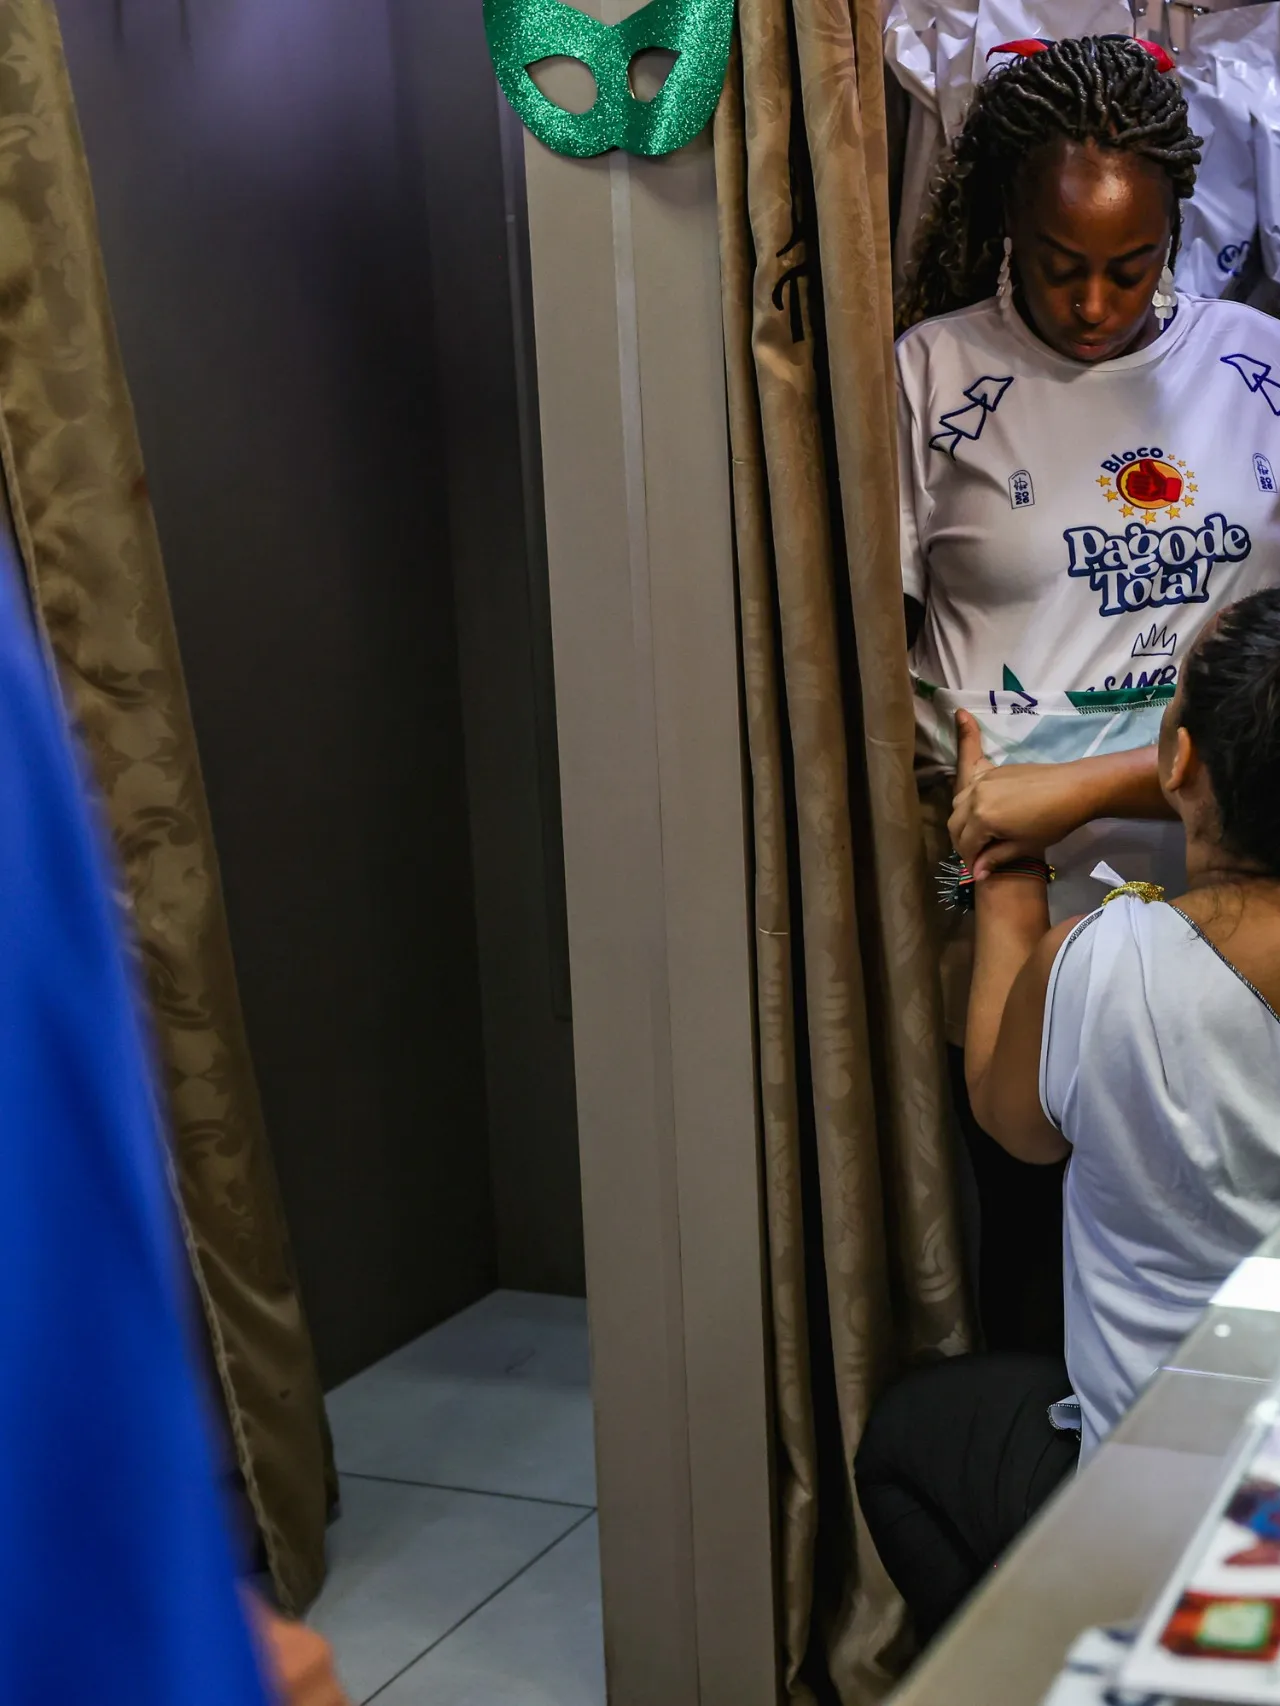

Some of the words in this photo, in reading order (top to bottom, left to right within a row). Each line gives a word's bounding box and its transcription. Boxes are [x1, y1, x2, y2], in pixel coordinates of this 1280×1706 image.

[1101, 446, 1164, 474] Bloco
[1064, 514, 1250, 577] Pagode
[1092, 558, 1208, 614] Total
